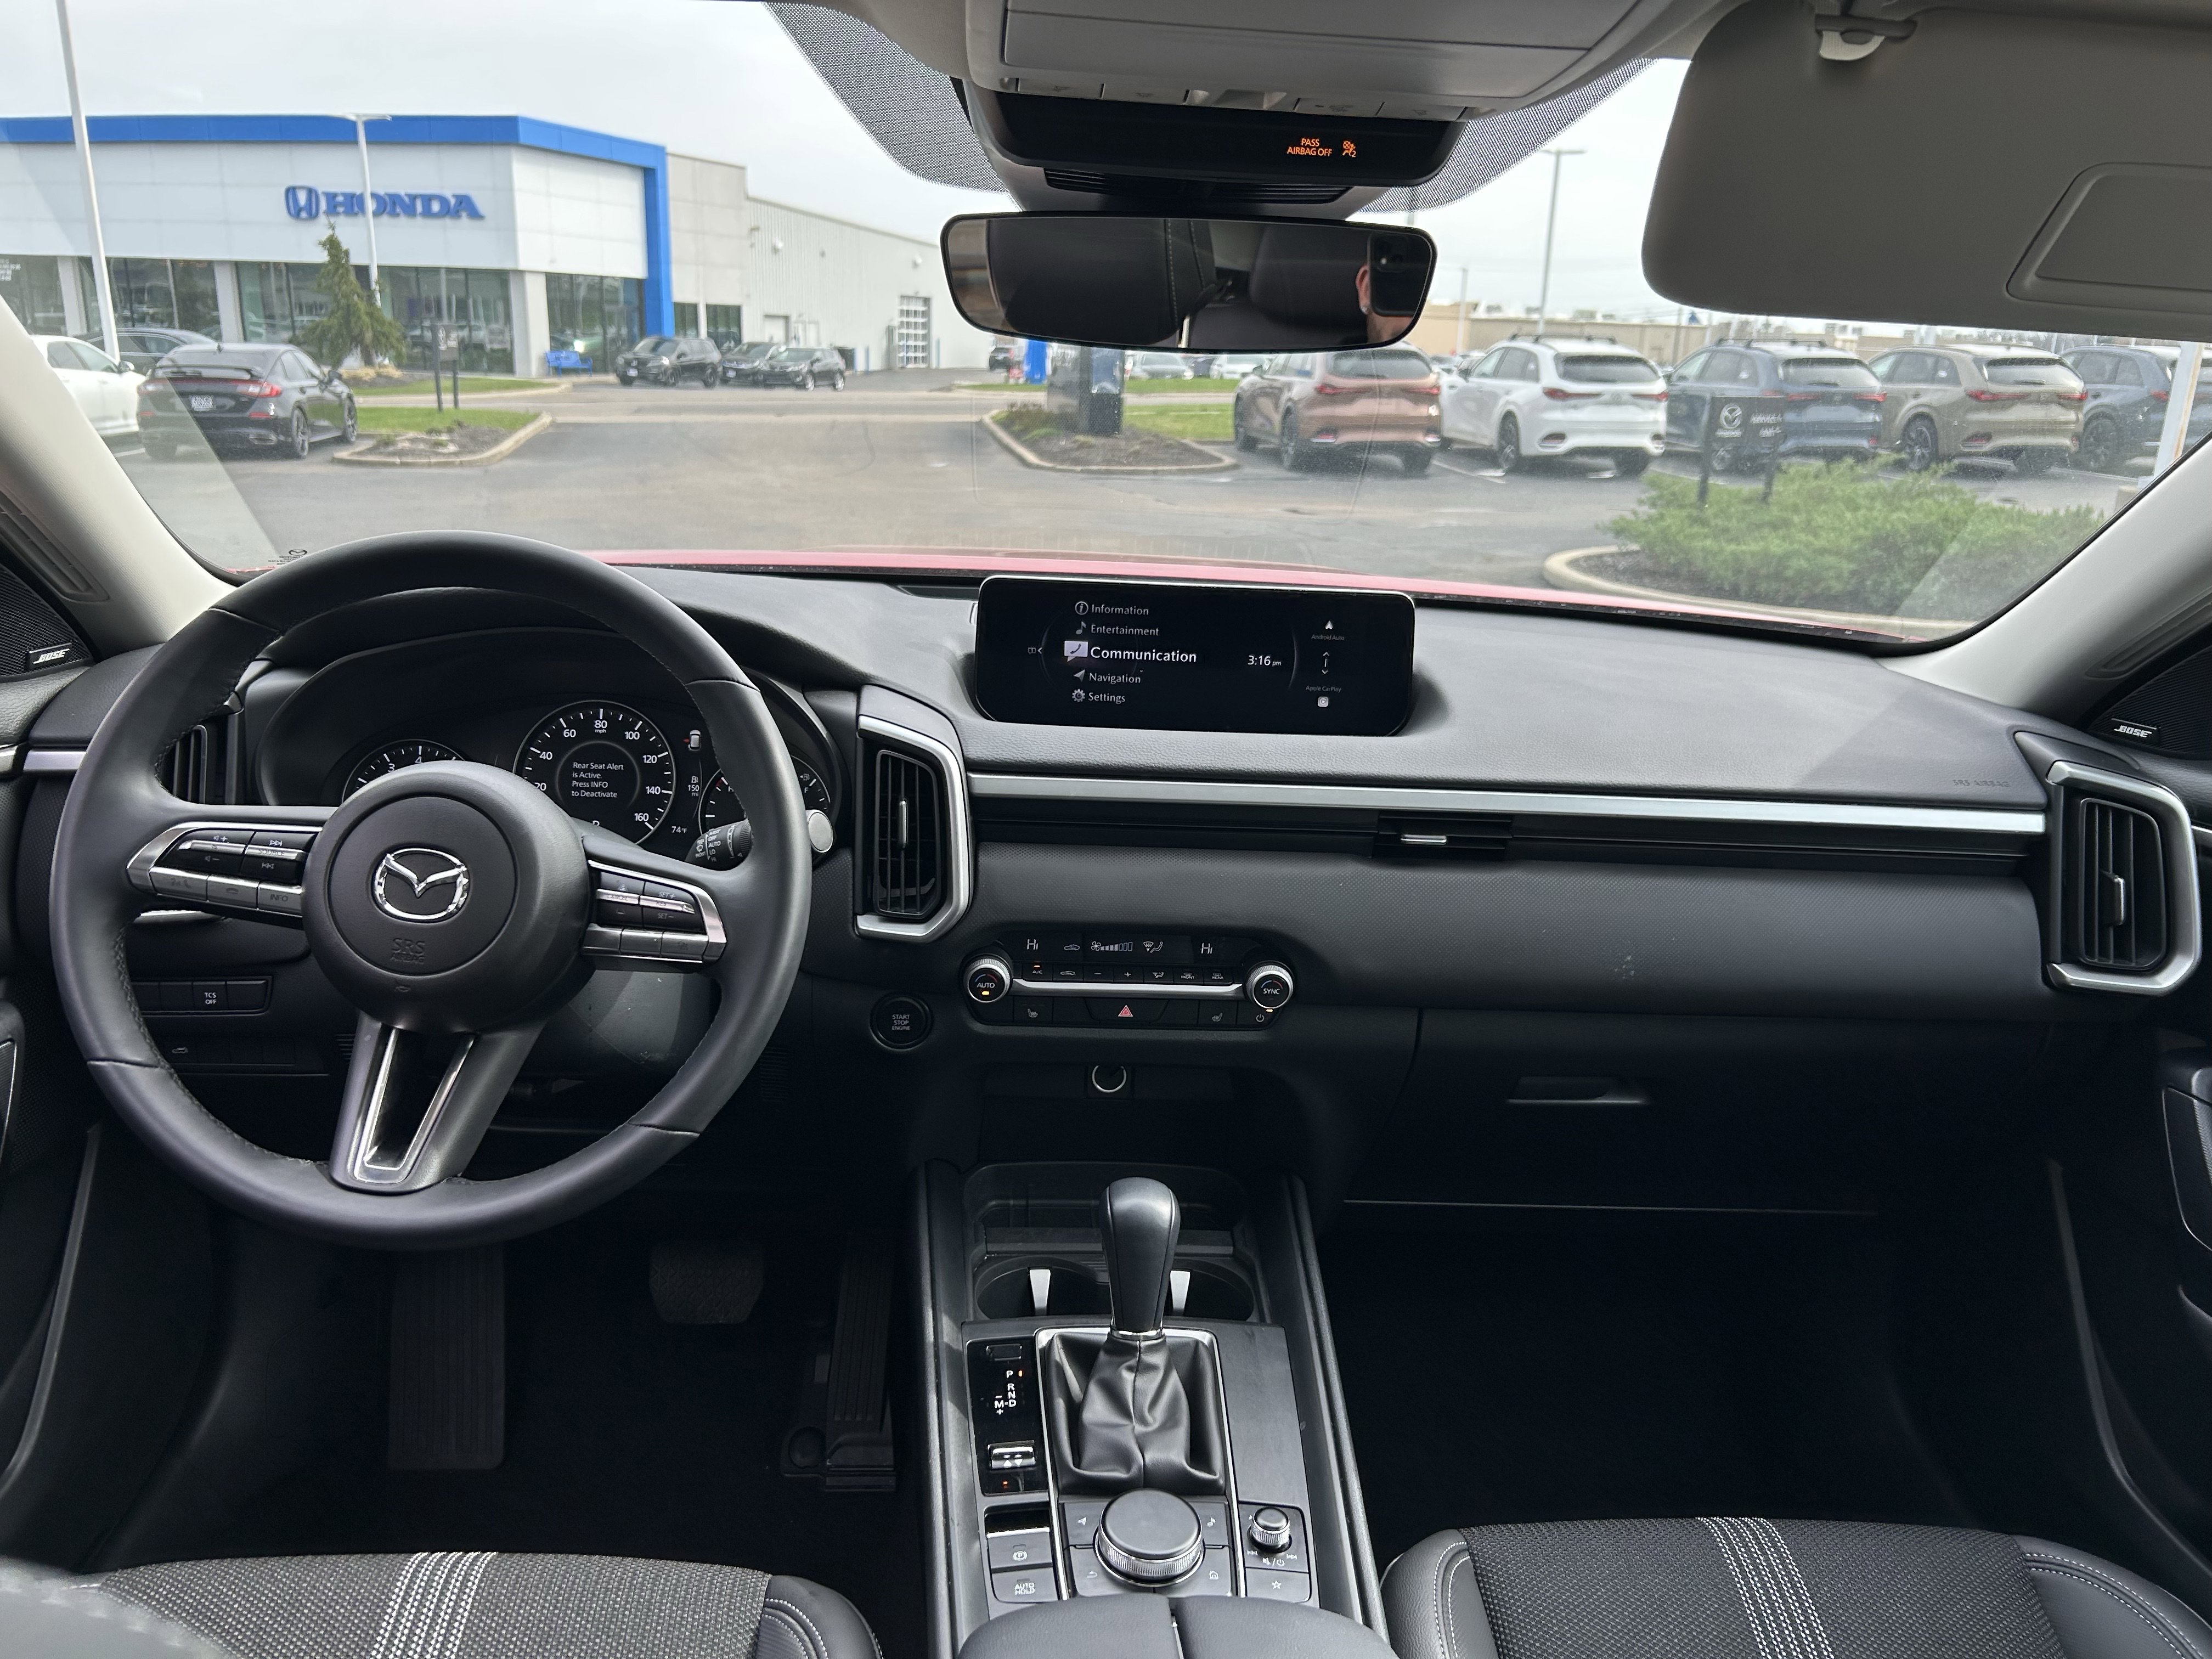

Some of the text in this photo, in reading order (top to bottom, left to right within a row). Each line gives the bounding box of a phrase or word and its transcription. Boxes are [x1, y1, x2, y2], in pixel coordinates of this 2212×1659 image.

[1301, 138, 1319, 146] PASS
[1287, 146, 1333, 156] AIRBAG OFF
[321, 192, 485, 219] HONDA
[1092, 605, 1149, 616] Information
[1091, 624, 1159, 636] Entertainment
[33, 648, 70, 664] BOSE
[1090, 647, 1197, 663] Communication
[1248, 656, 1271, 666] 3:16
[1089, 673, 1141, 684] Navigation
[1088, 692, 1126, 704] Settings
[594, 720, 607, 729] 80
[563, 729, 576, 738] 60
[625, 731, 640, 740] 100
[2113, 725, 2152, 738] BOSE
[539, 752, 553, 760] 40
[643, 755, 657, 764] 120
[387, 763, 395, 772] 3
[646, 786, 661, 794] 140
[634, 813, 649, 821] 160
[269, 894, 288, 902] INFO
[392, 938, 425, 956] SRS
[390, 953, 425, 964] AIRBAG
